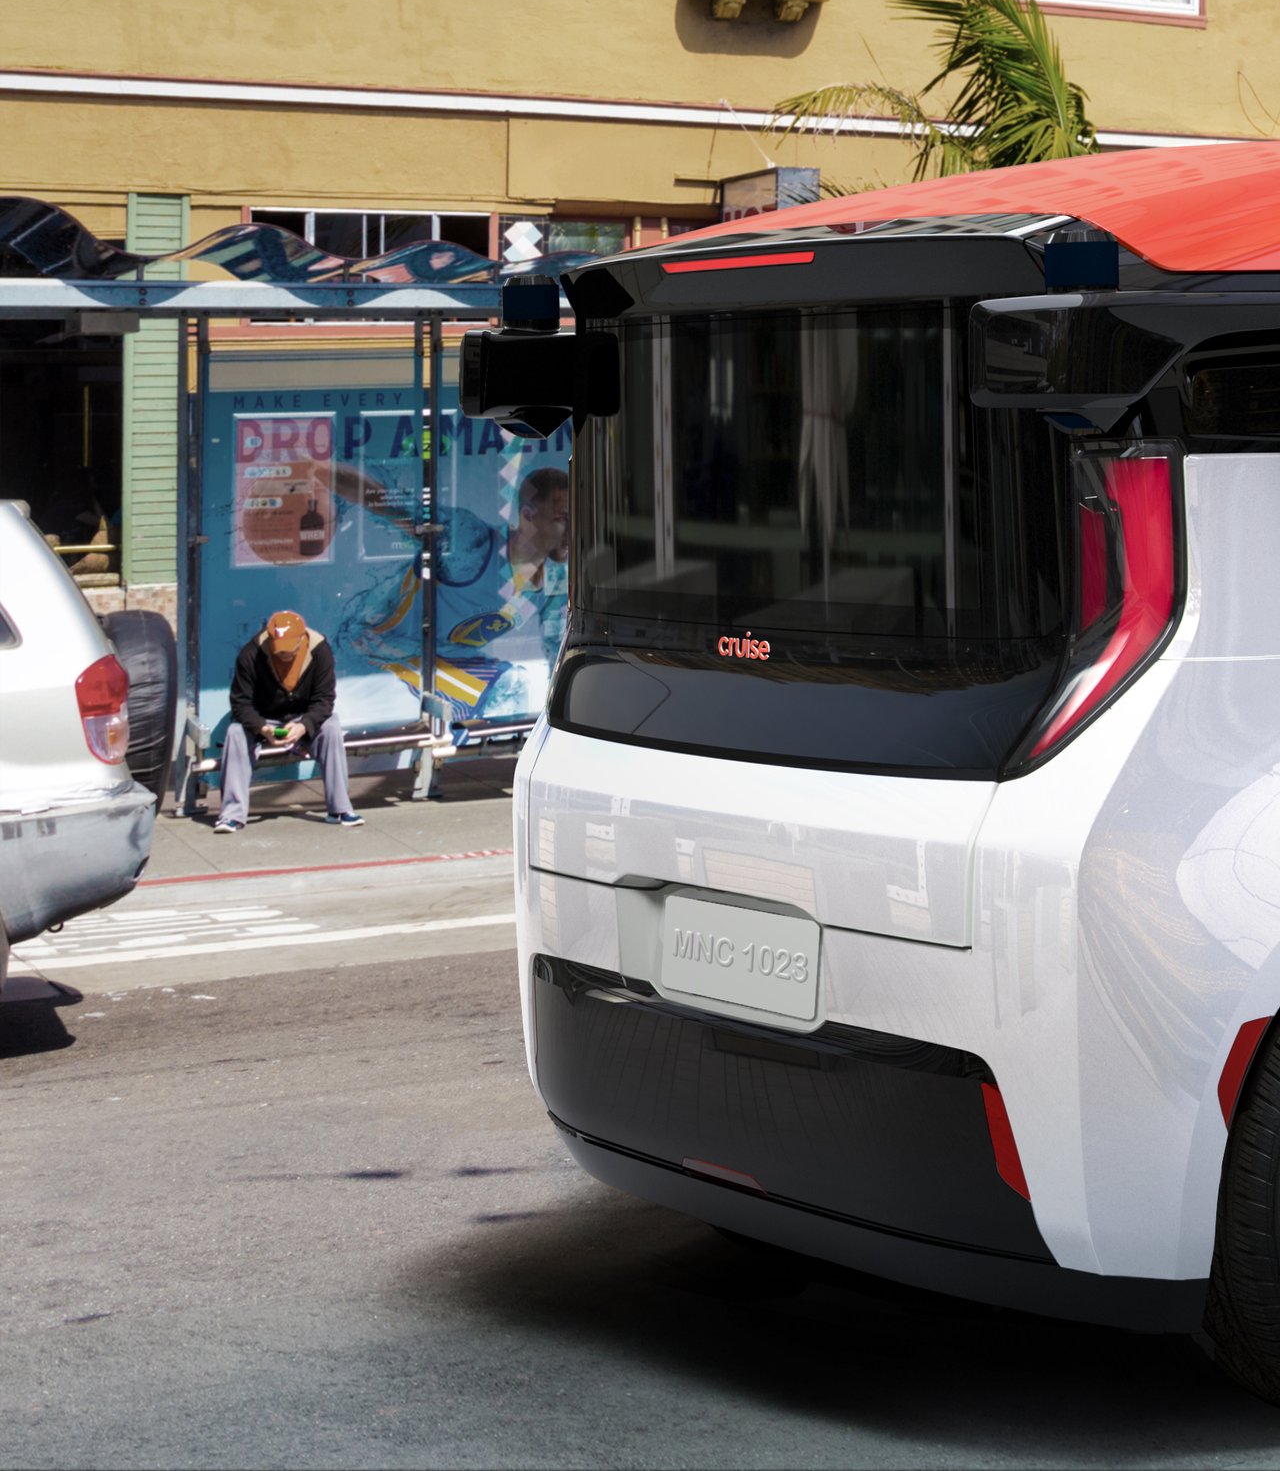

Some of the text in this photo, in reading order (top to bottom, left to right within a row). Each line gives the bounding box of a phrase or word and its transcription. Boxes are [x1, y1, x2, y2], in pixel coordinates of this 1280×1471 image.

[233, 392, 403, 409] MAKE EVERY
[235, 416, 372, 463] DROP
[718, 631, 770, 661] cruise
[672, 928, 809, 984] MNC 1023
